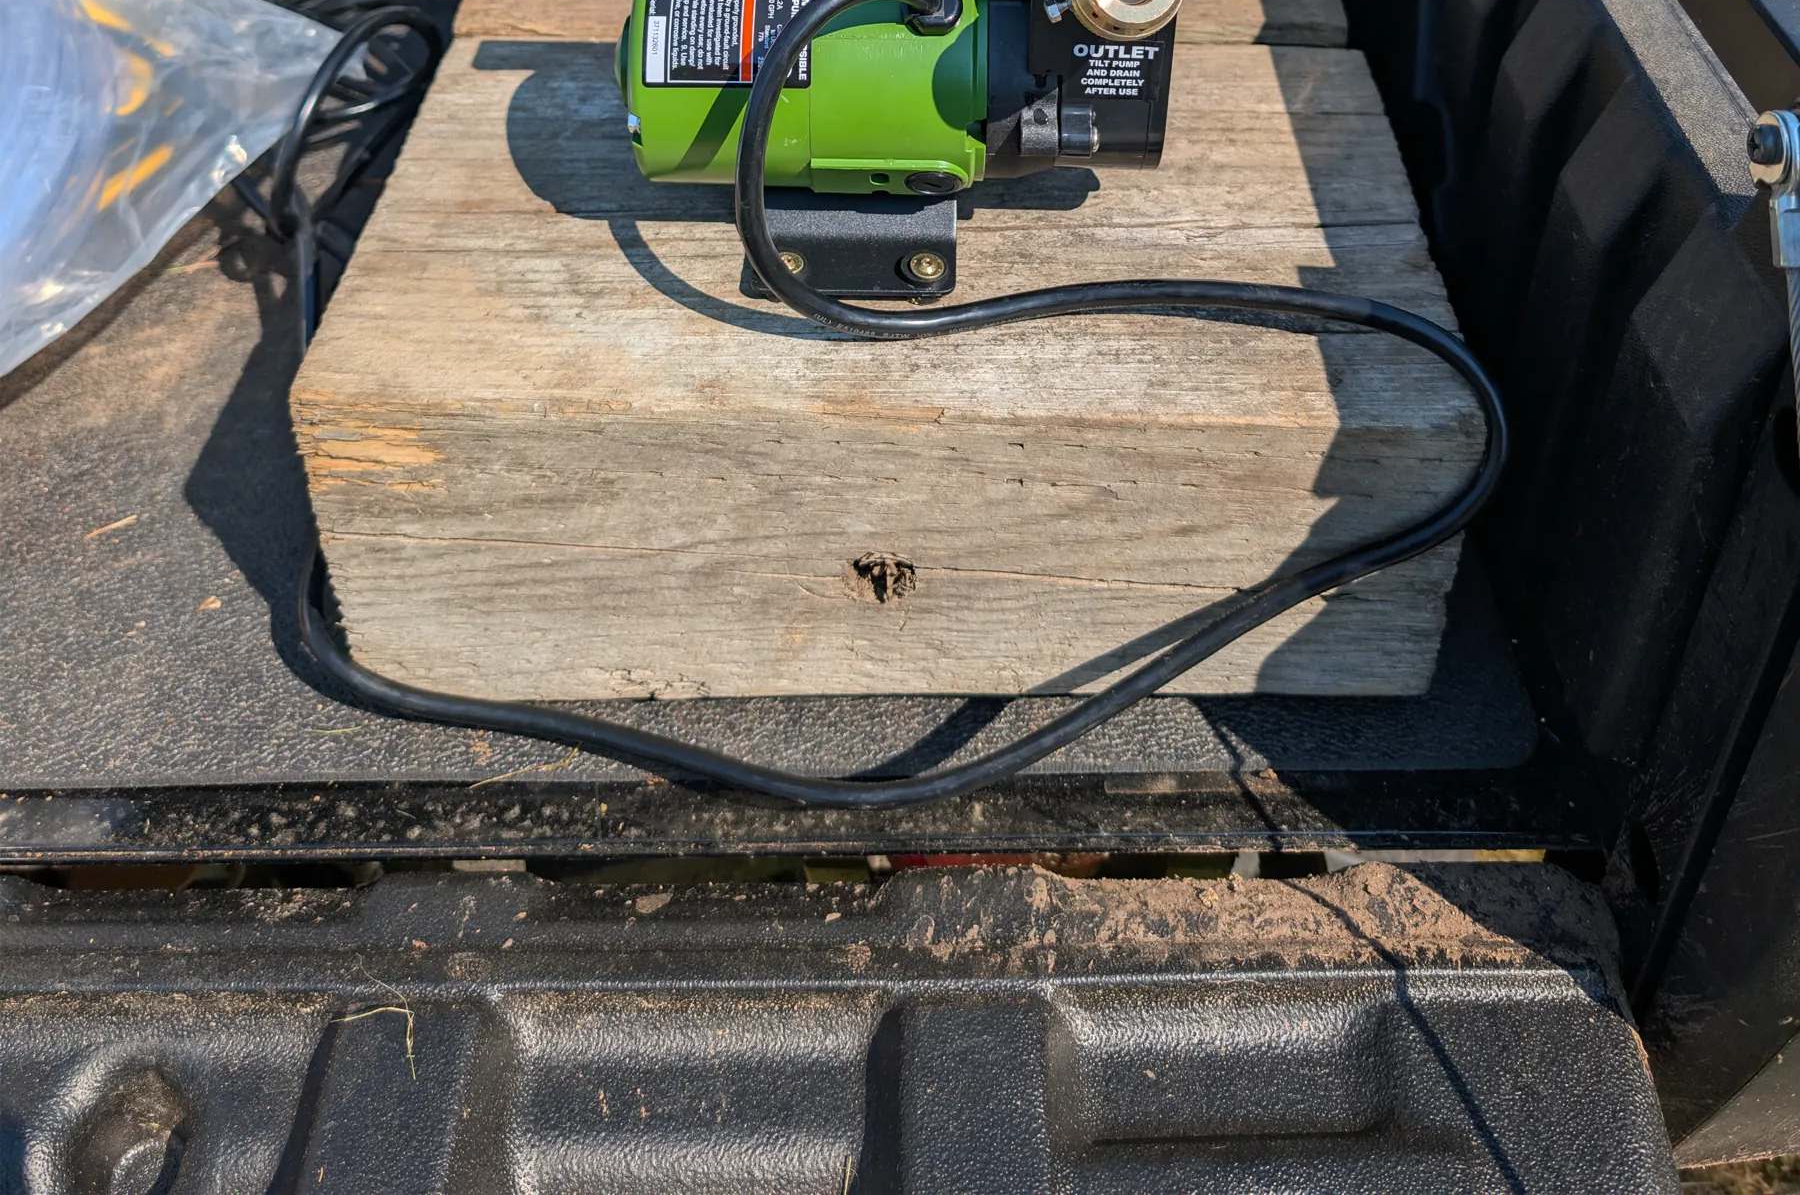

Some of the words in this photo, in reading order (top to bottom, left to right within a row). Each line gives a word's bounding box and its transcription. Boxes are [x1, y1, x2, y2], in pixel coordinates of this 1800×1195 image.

[707, 0, 715, 28] evaluated
[791, 0, 799, 18] PU
[689, 10, 698, 35] standing
[690, 36, 696, 44] on
[714, 18, 722, 55] investigated
[698, 49, 704, 58] do
[1073, 44, 1159, 59] OUTLET
[1081, 78, 1144, 86] COMPLETELY
